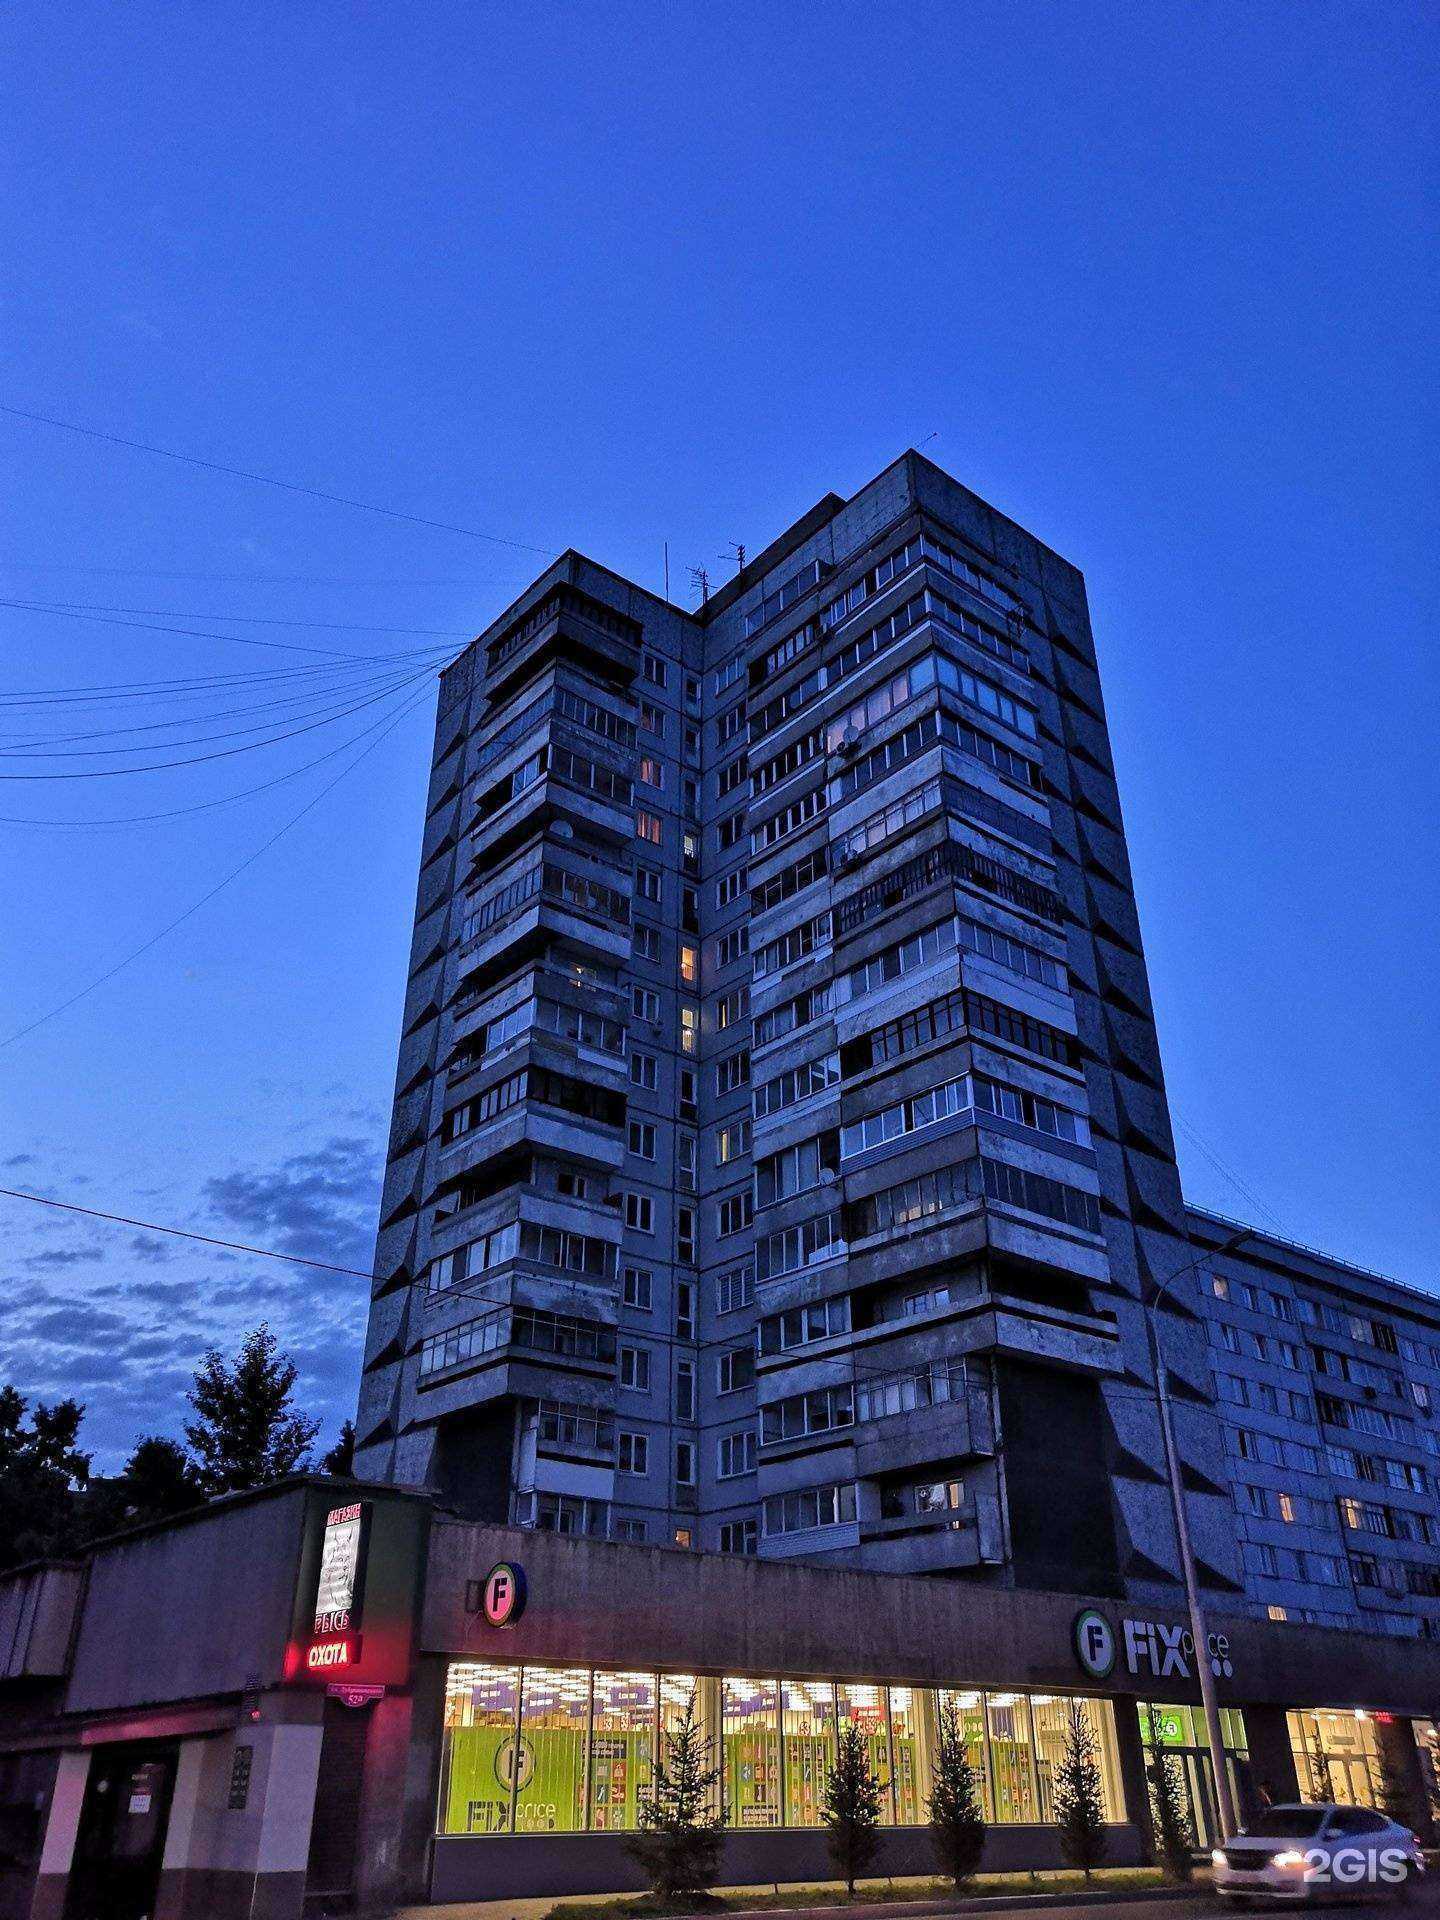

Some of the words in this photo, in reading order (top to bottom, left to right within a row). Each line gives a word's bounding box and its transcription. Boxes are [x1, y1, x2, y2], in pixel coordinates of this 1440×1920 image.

[492, 1578, 508, 1612] F
[309, 1643, 348, 1667] ОХОТА
[1087, 1625, 1104, 1661] F
[1181, 1630, 1230, 1660] pce
